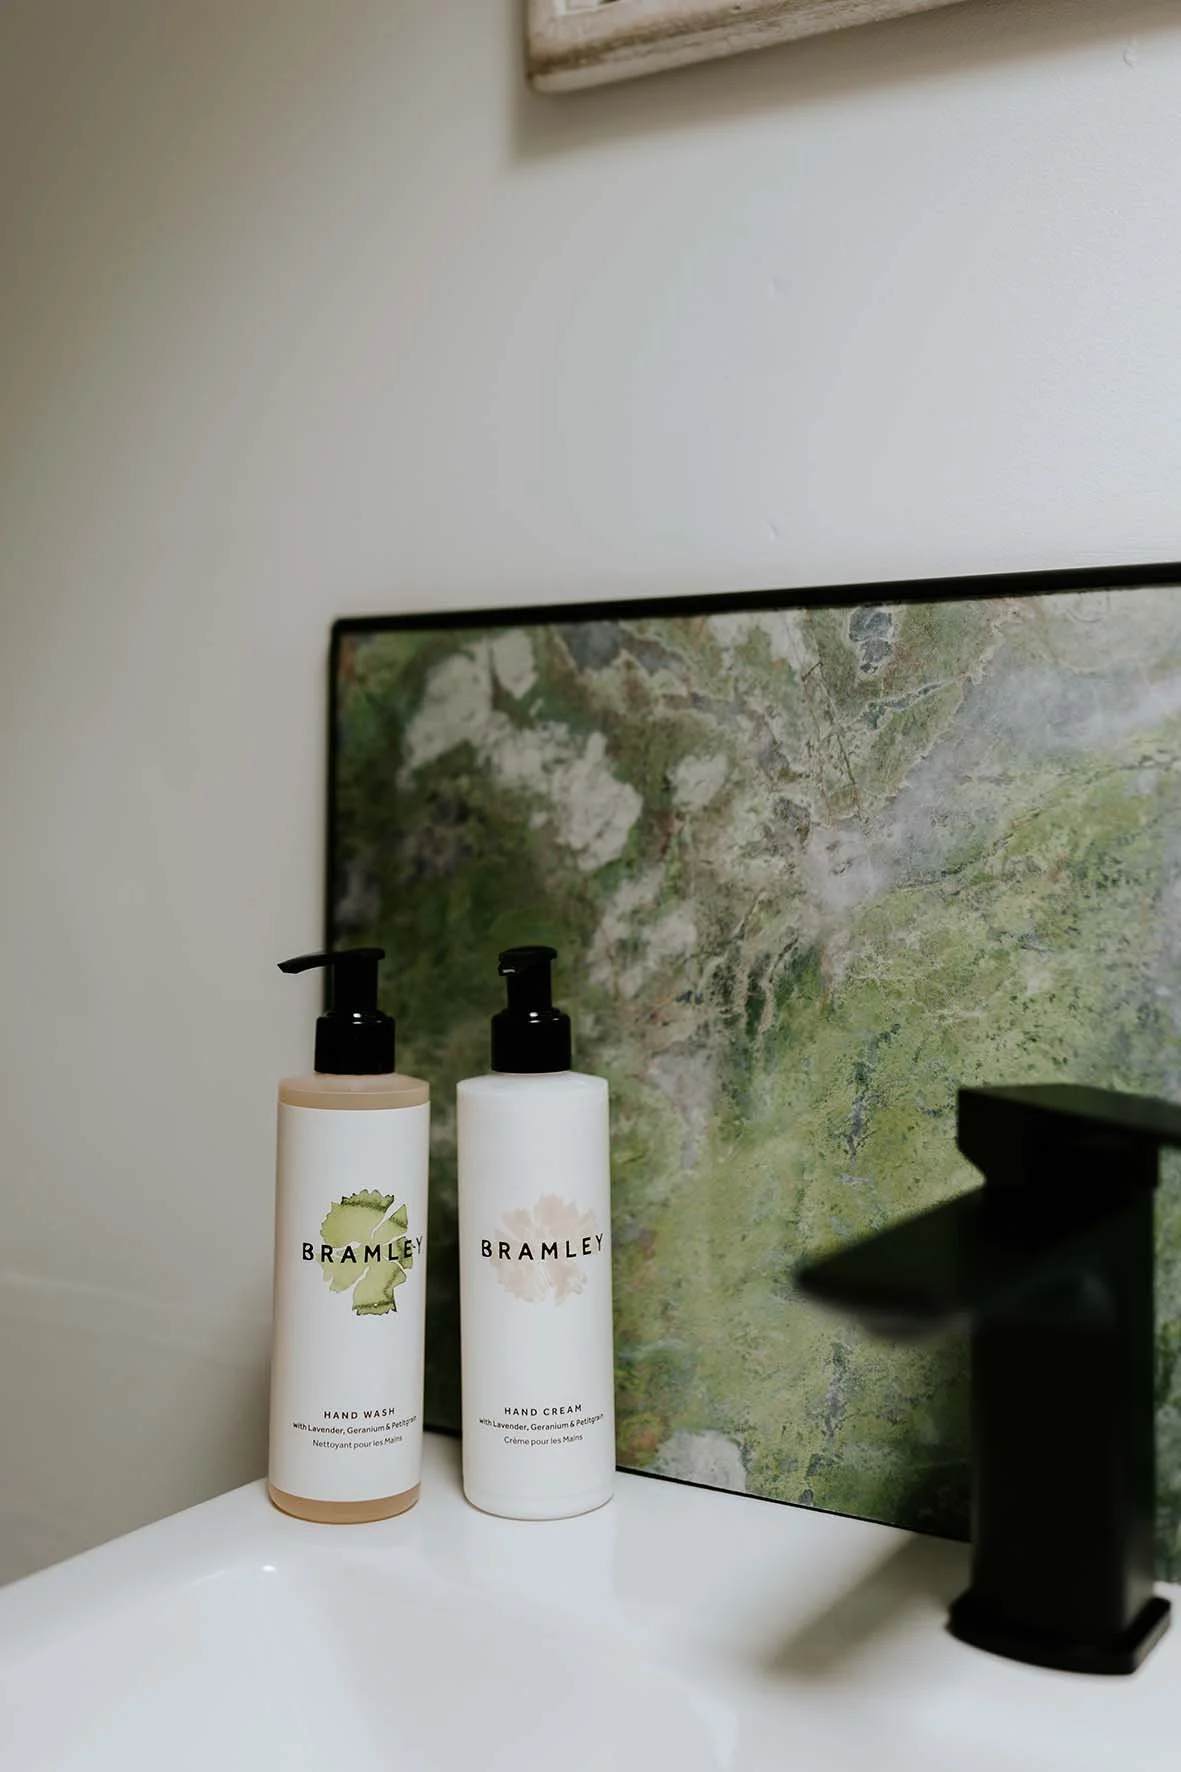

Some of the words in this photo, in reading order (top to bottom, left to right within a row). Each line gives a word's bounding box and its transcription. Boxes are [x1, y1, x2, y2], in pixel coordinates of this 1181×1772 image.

[302, 1236, 423, 1264] BRAMLEY
[481, 1233, 604, 1261] BRAMLEY
[323, 1411, 359, 1420] HAND
[363, 1407, 396, 1419] WASH
[504, 1407, 538, 1417] HAND
[543, 1404, 583, 1416] CREAM
[292, 1422, 308, 1431] with
[308, 1424, 346, 1435] Lavender,
[347, 1425, 385, 1434] Geranium
[386, 1423, 391, 1431] &
[392, 1415, 417, 1429] Petitgra
[479, 1418, 493, 1426] with
[493, 1421, 530, 1432] Lavender,
[530, 1422, 569, 1431] Geranium
[570, 1420, 575, 1428] &
[576, 1413, 603, 1425] Petitgra
[312, 1439, 353, 1450] Nettoyant
[353, 1440, 372, 1450] pour
[530, 1438, 549, 1447] pour
[562, 1434, 584, 1443] Mains
